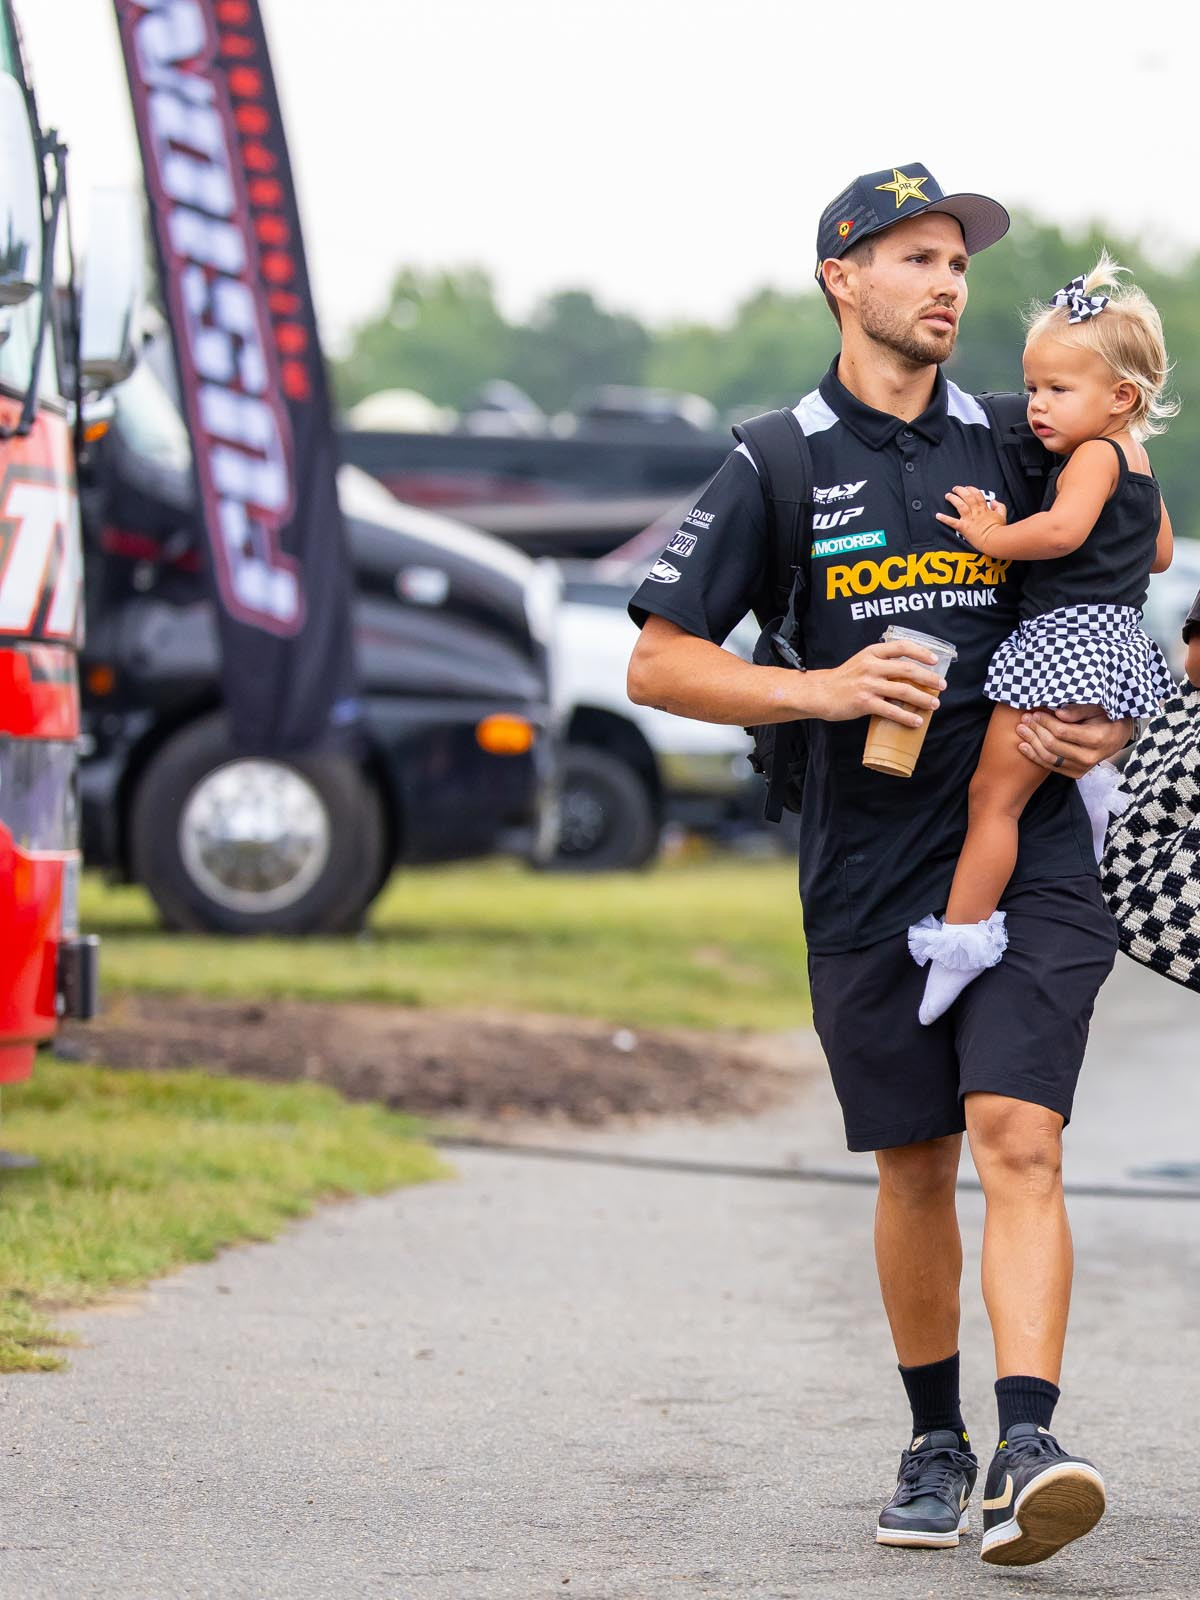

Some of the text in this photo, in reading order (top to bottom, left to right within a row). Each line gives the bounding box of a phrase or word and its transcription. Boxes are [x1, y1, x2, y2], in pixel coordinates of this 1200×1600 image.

[815, 532, 882, 555] MOTOREX
[827, 551, 1012, 600] ROCKSTAR
[851, 588, 997, 620] ENERGY DRINK
